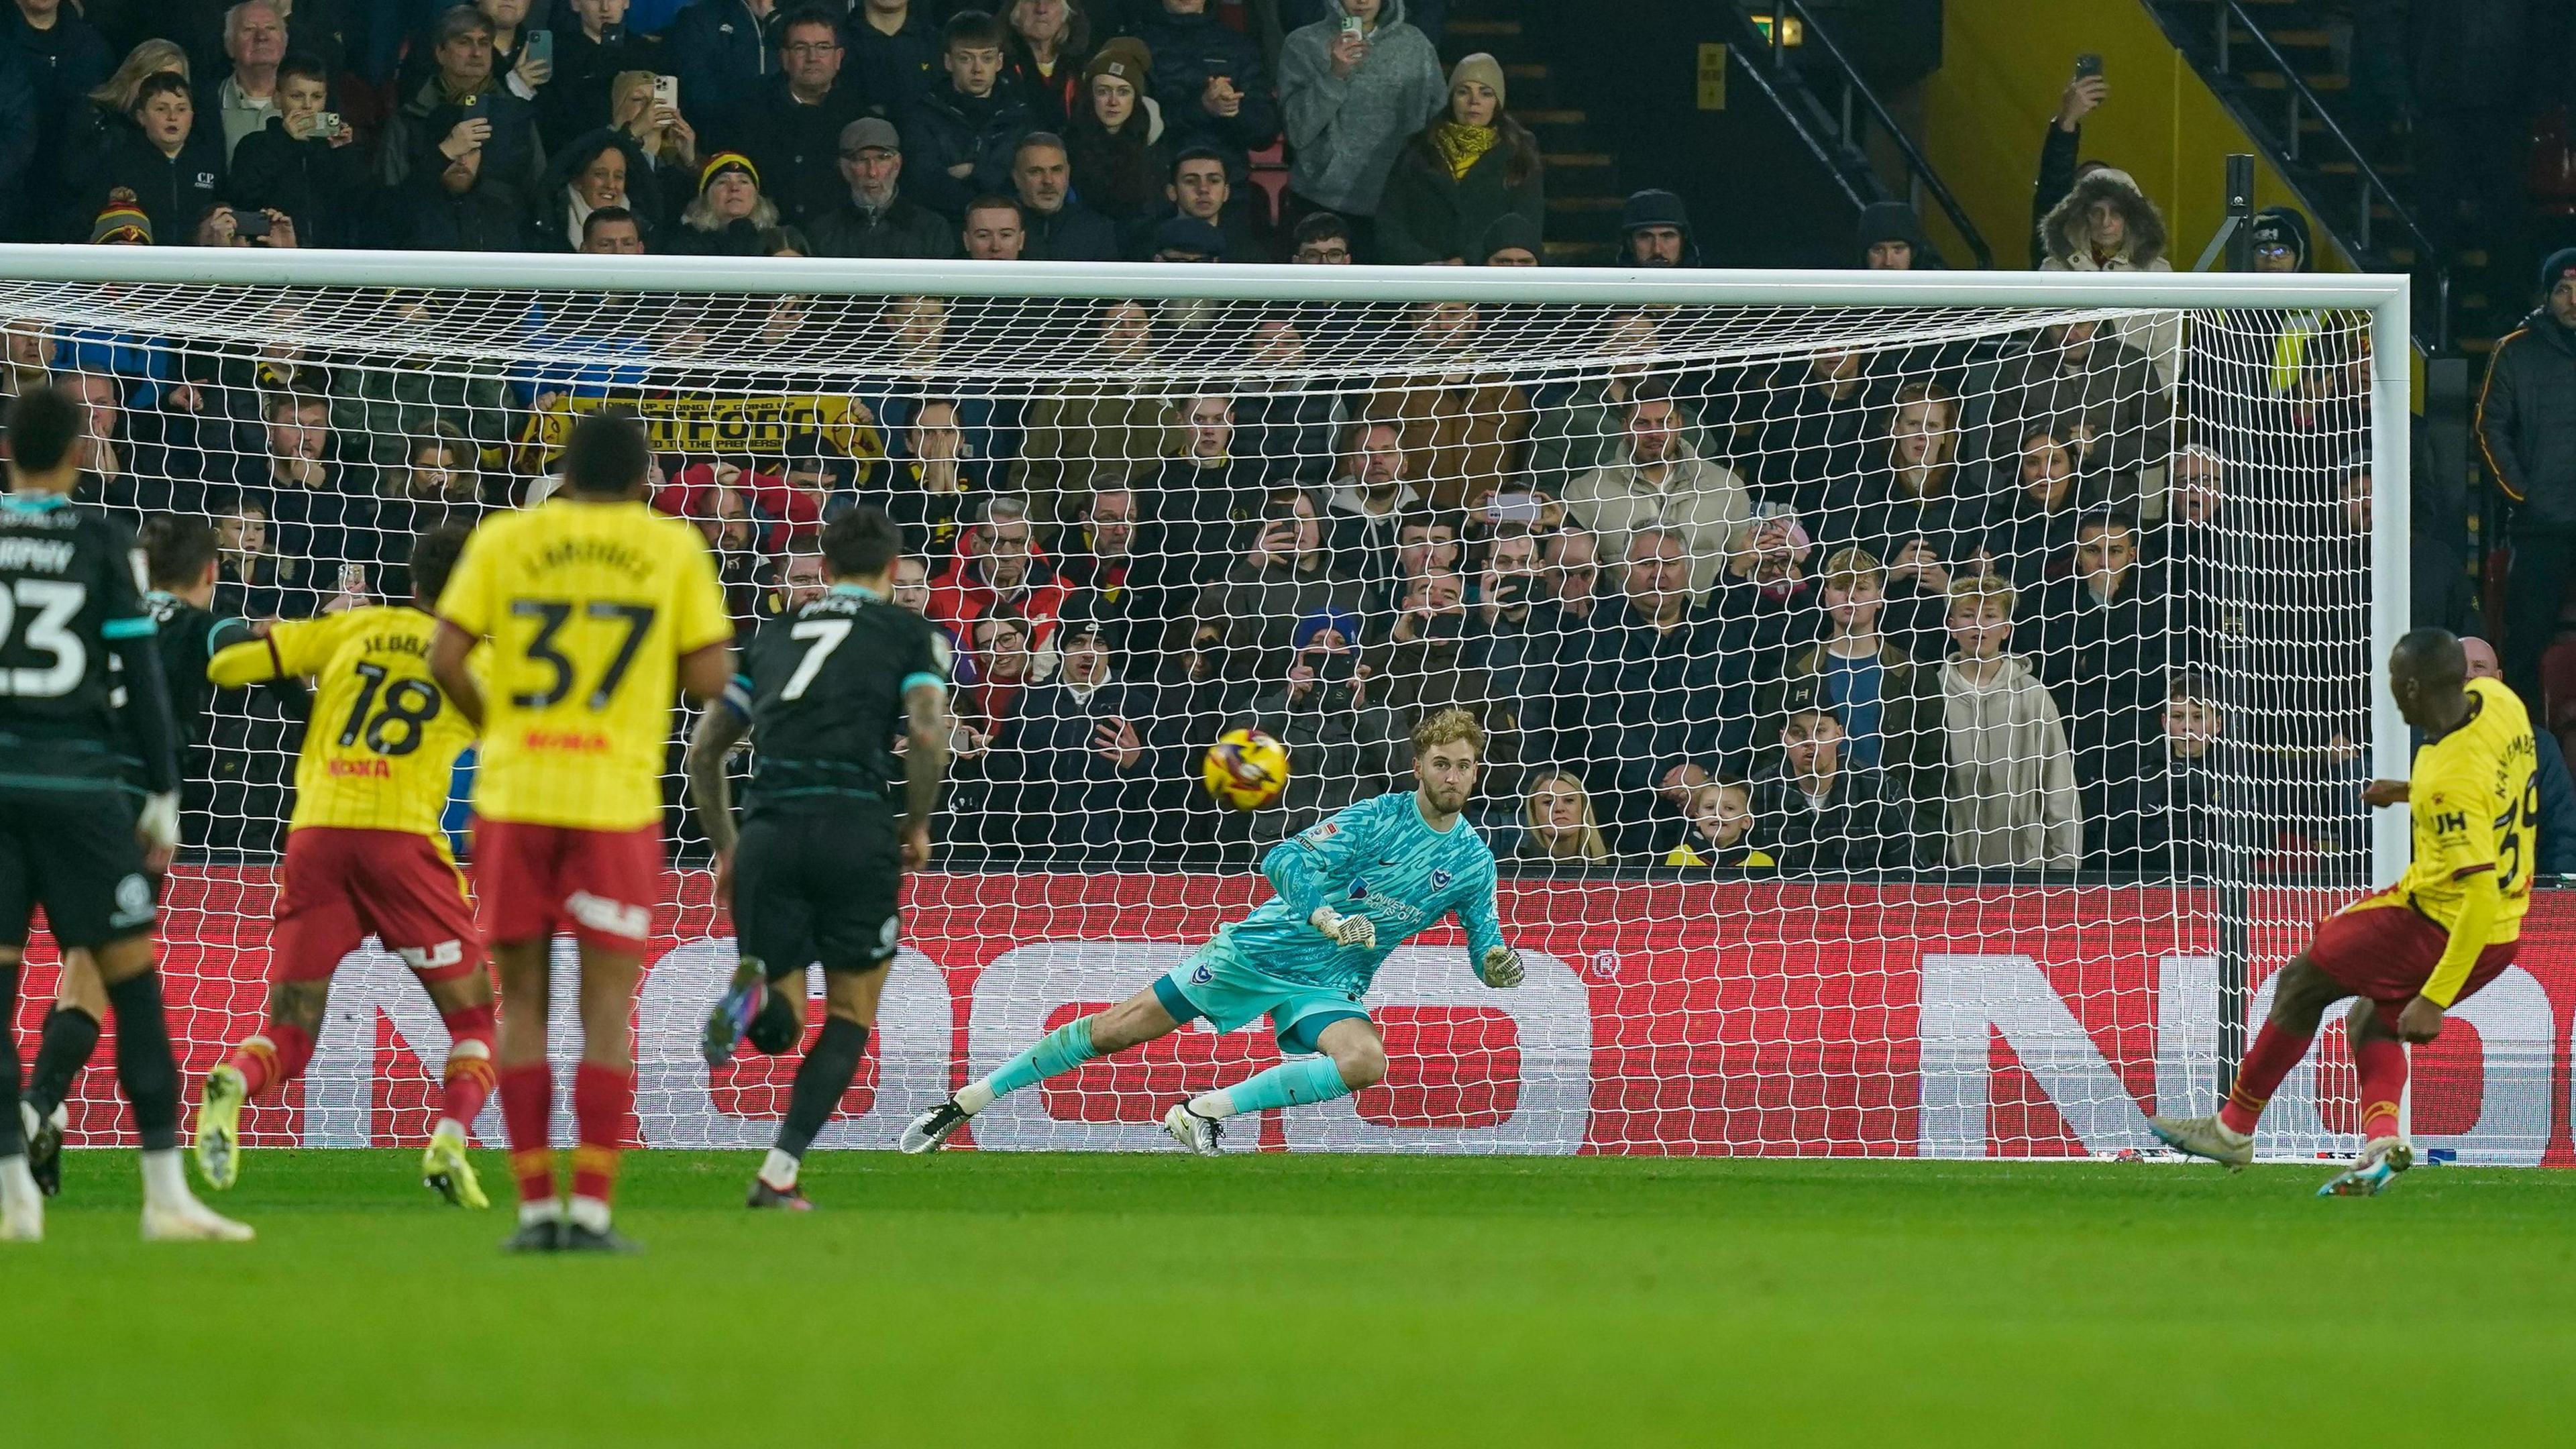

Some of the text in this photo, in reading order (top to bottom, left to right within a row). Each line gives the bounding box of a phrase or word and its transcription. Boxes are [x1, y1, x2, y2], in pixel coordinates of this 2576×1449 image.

[584, 409, 826, 441] TFORD
[689, 439, 713, 448] THE
[716, 439, 786, 447] PREMIERSH
[0, 536, 75, 573] RPHY
[0, 575, 87, 698] 3
[511, 600, 655, 710] 37
[780, 619, 853, 701] 7
[338, 661, 441, 756] 18
[2495, 734, 2536, 799] KAYEMB
[2436, 810, 2467, 835] JH
[2493, 769, 2538, 889] 39
[1370, 892, 1423, 917] UNIVERITY
[1919, 954, 2576, 1168] NO
